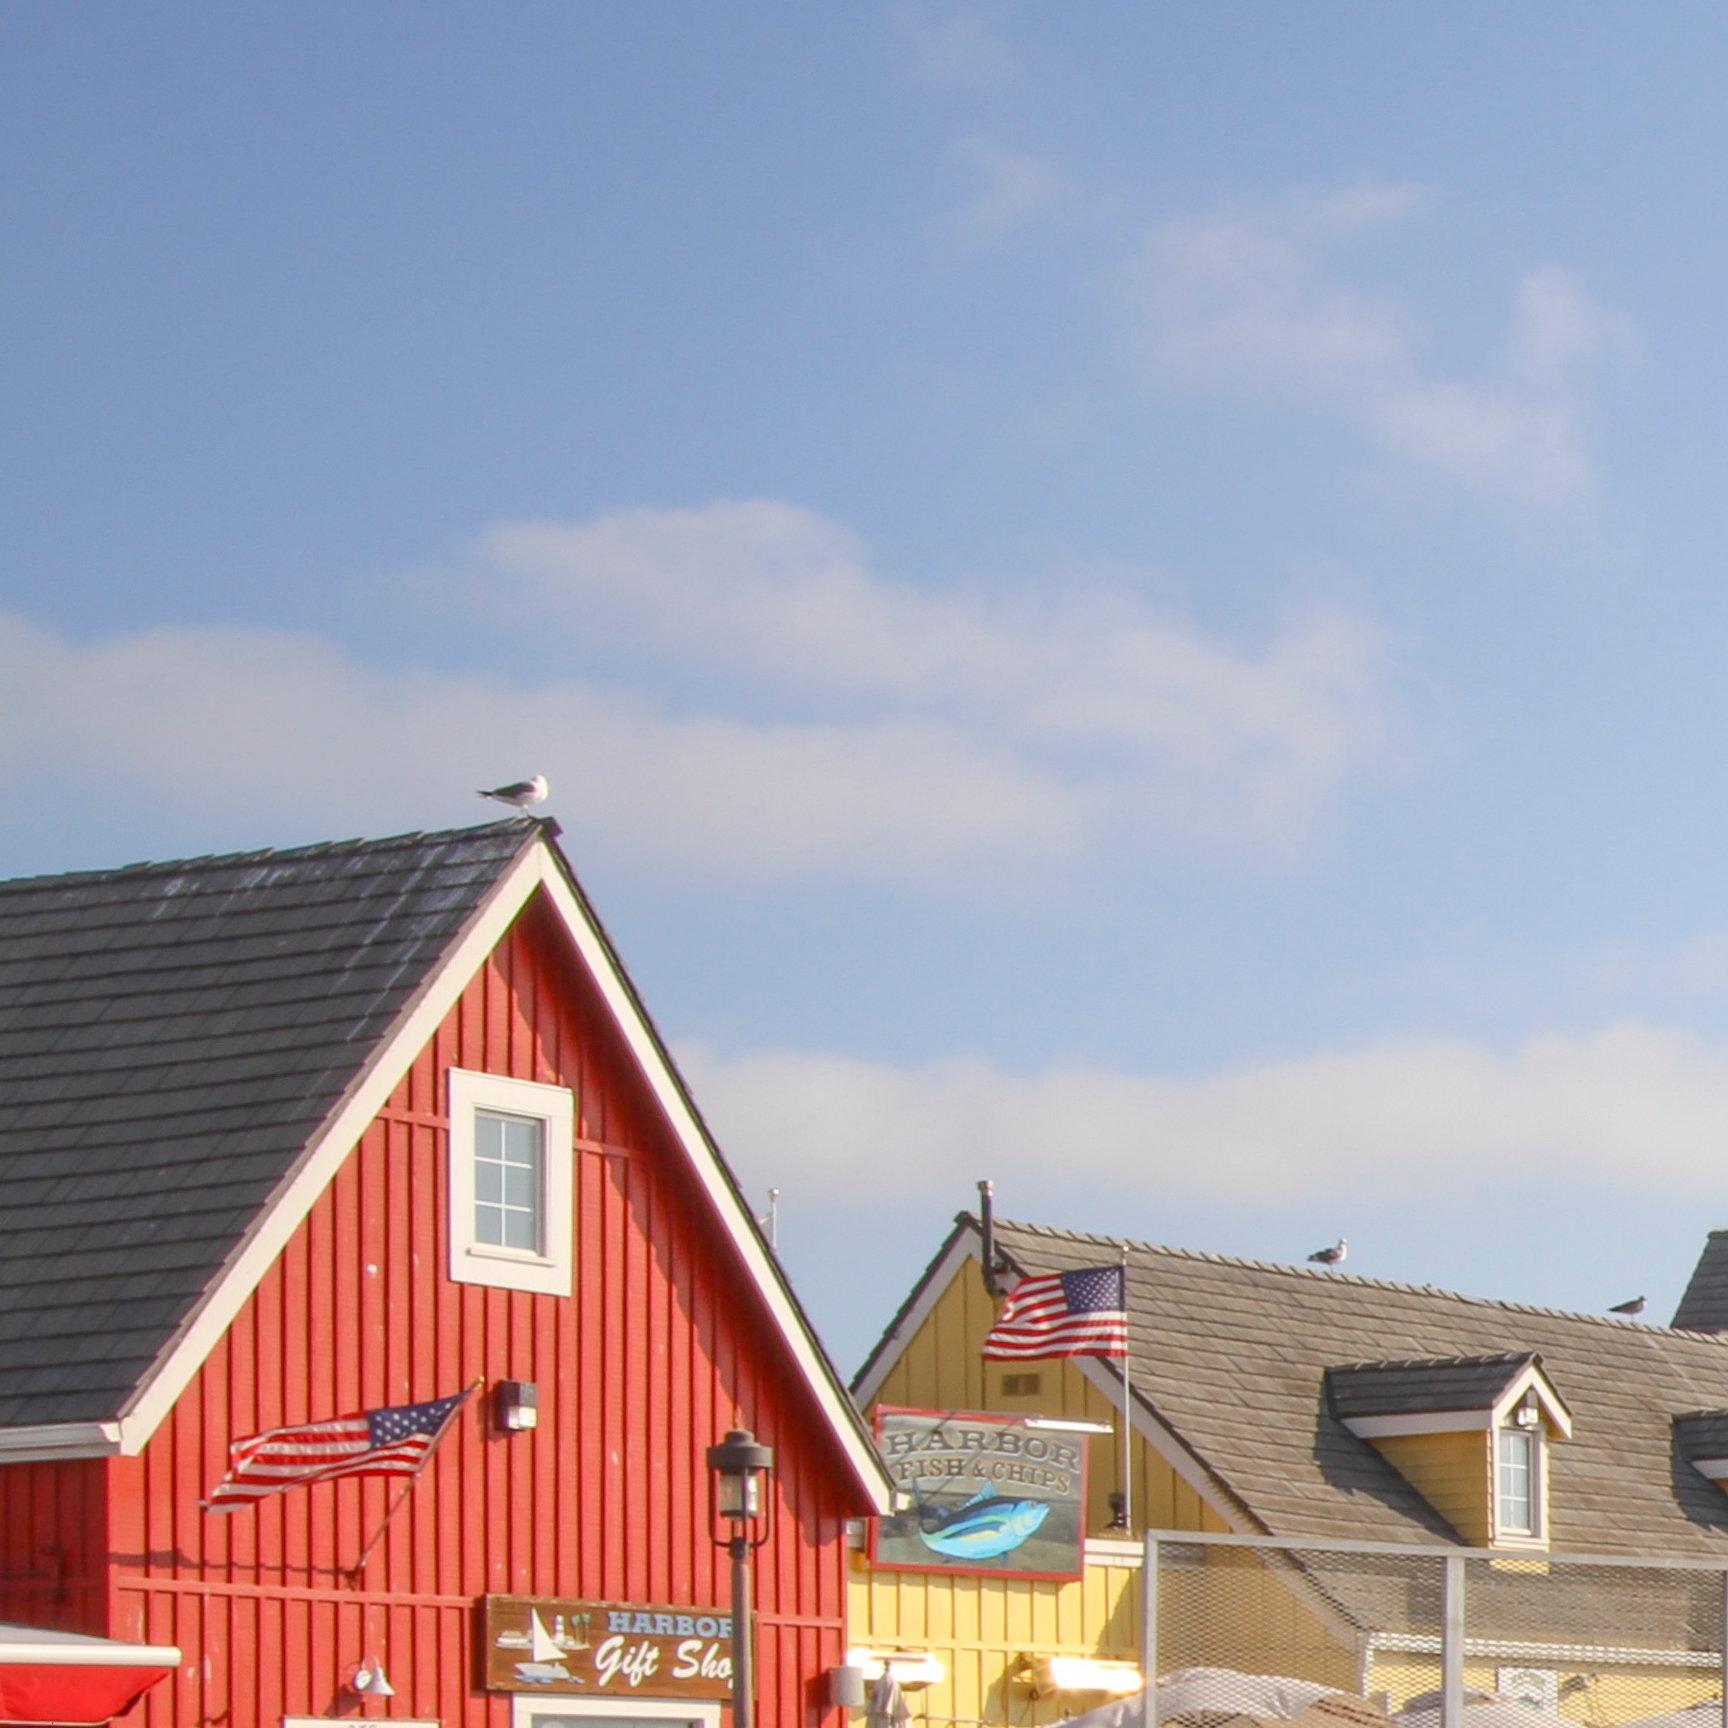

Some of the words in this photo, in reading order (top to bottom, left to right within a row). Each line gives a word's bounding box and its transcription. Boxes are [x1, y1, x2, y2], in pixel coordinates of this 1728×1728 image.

[885, 1430, 1080, 1472] HARBOR
[899, 1458, 966, 1481] FISH
[971, 1461, 988, 1479] &
[992, 1461, 1071, 1495] CHIPS
[595, 1635, 660, 1687] Gift
[672, 1639, 734, 1690] Sho
